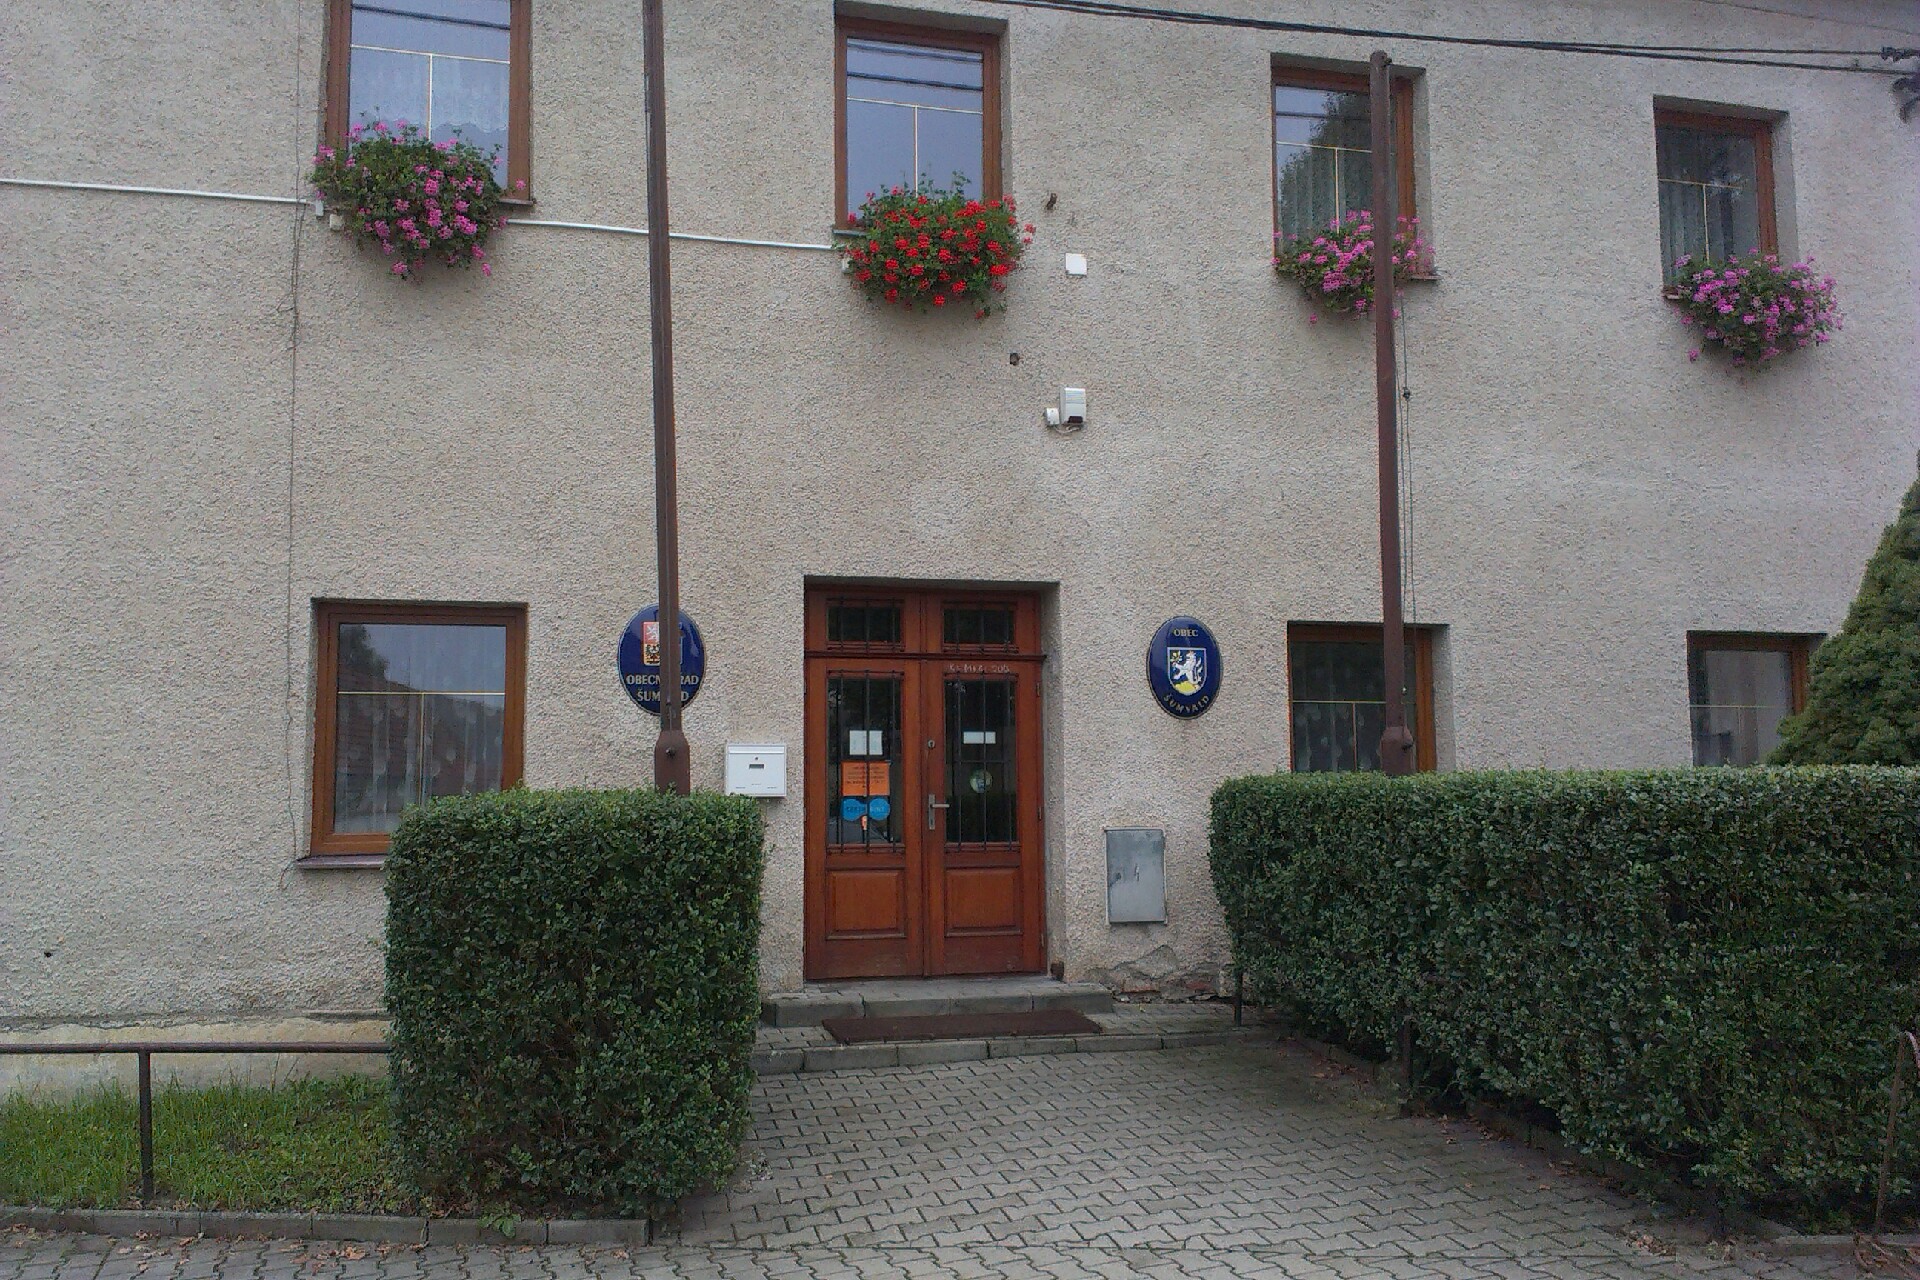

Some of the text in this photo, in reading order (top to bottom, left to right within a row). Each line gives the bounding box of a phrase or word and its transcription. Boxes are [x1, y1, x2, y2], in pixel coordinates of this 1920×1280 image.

[1173, 629, 1199, 637] OBEC
[626, 674, 662, 685] OBECN
[637, 688, 690, 702] ŠUMD
